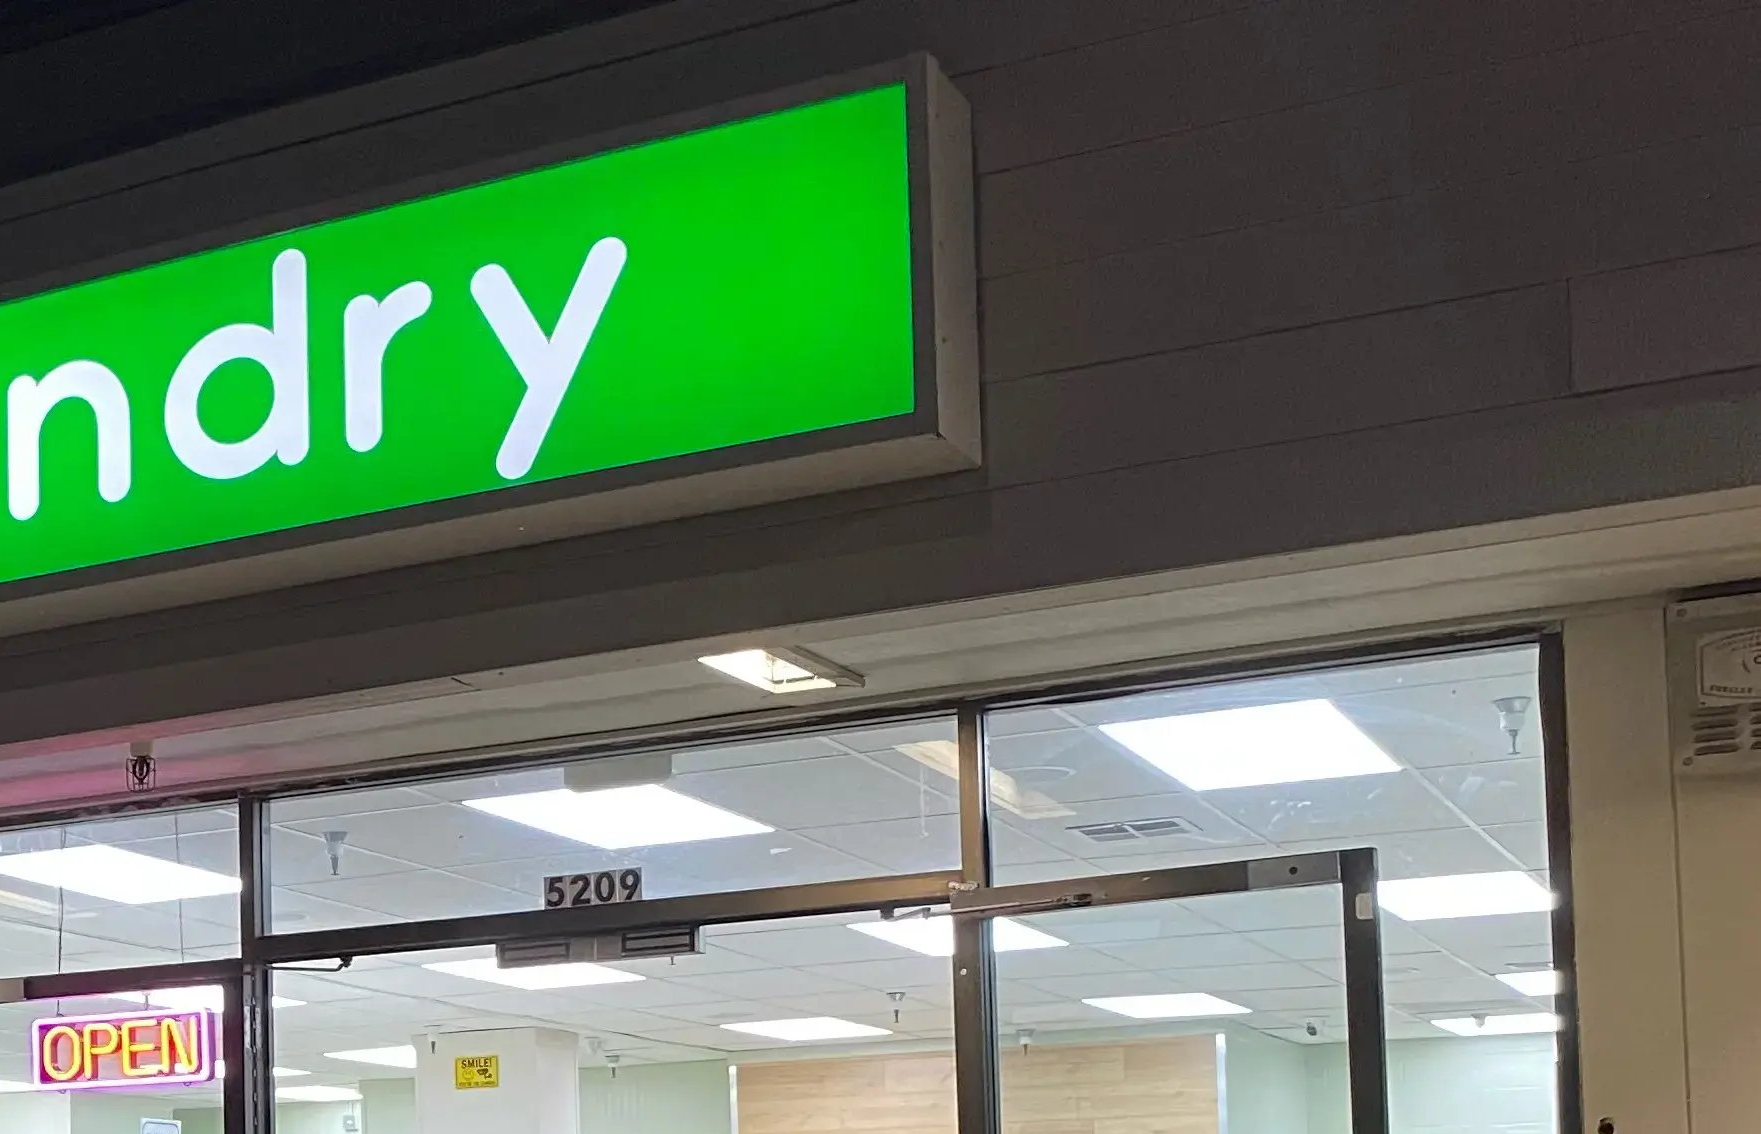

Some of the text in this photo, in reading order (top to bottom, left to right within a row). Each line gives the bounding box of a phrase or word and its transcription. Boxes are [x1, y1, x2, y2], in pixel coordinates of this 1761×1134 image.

[546, 869, 640, 908] 5209
[42, 1016, 198, 1081] OPEN
[461, 1057, 492, 1069] SMILE!
